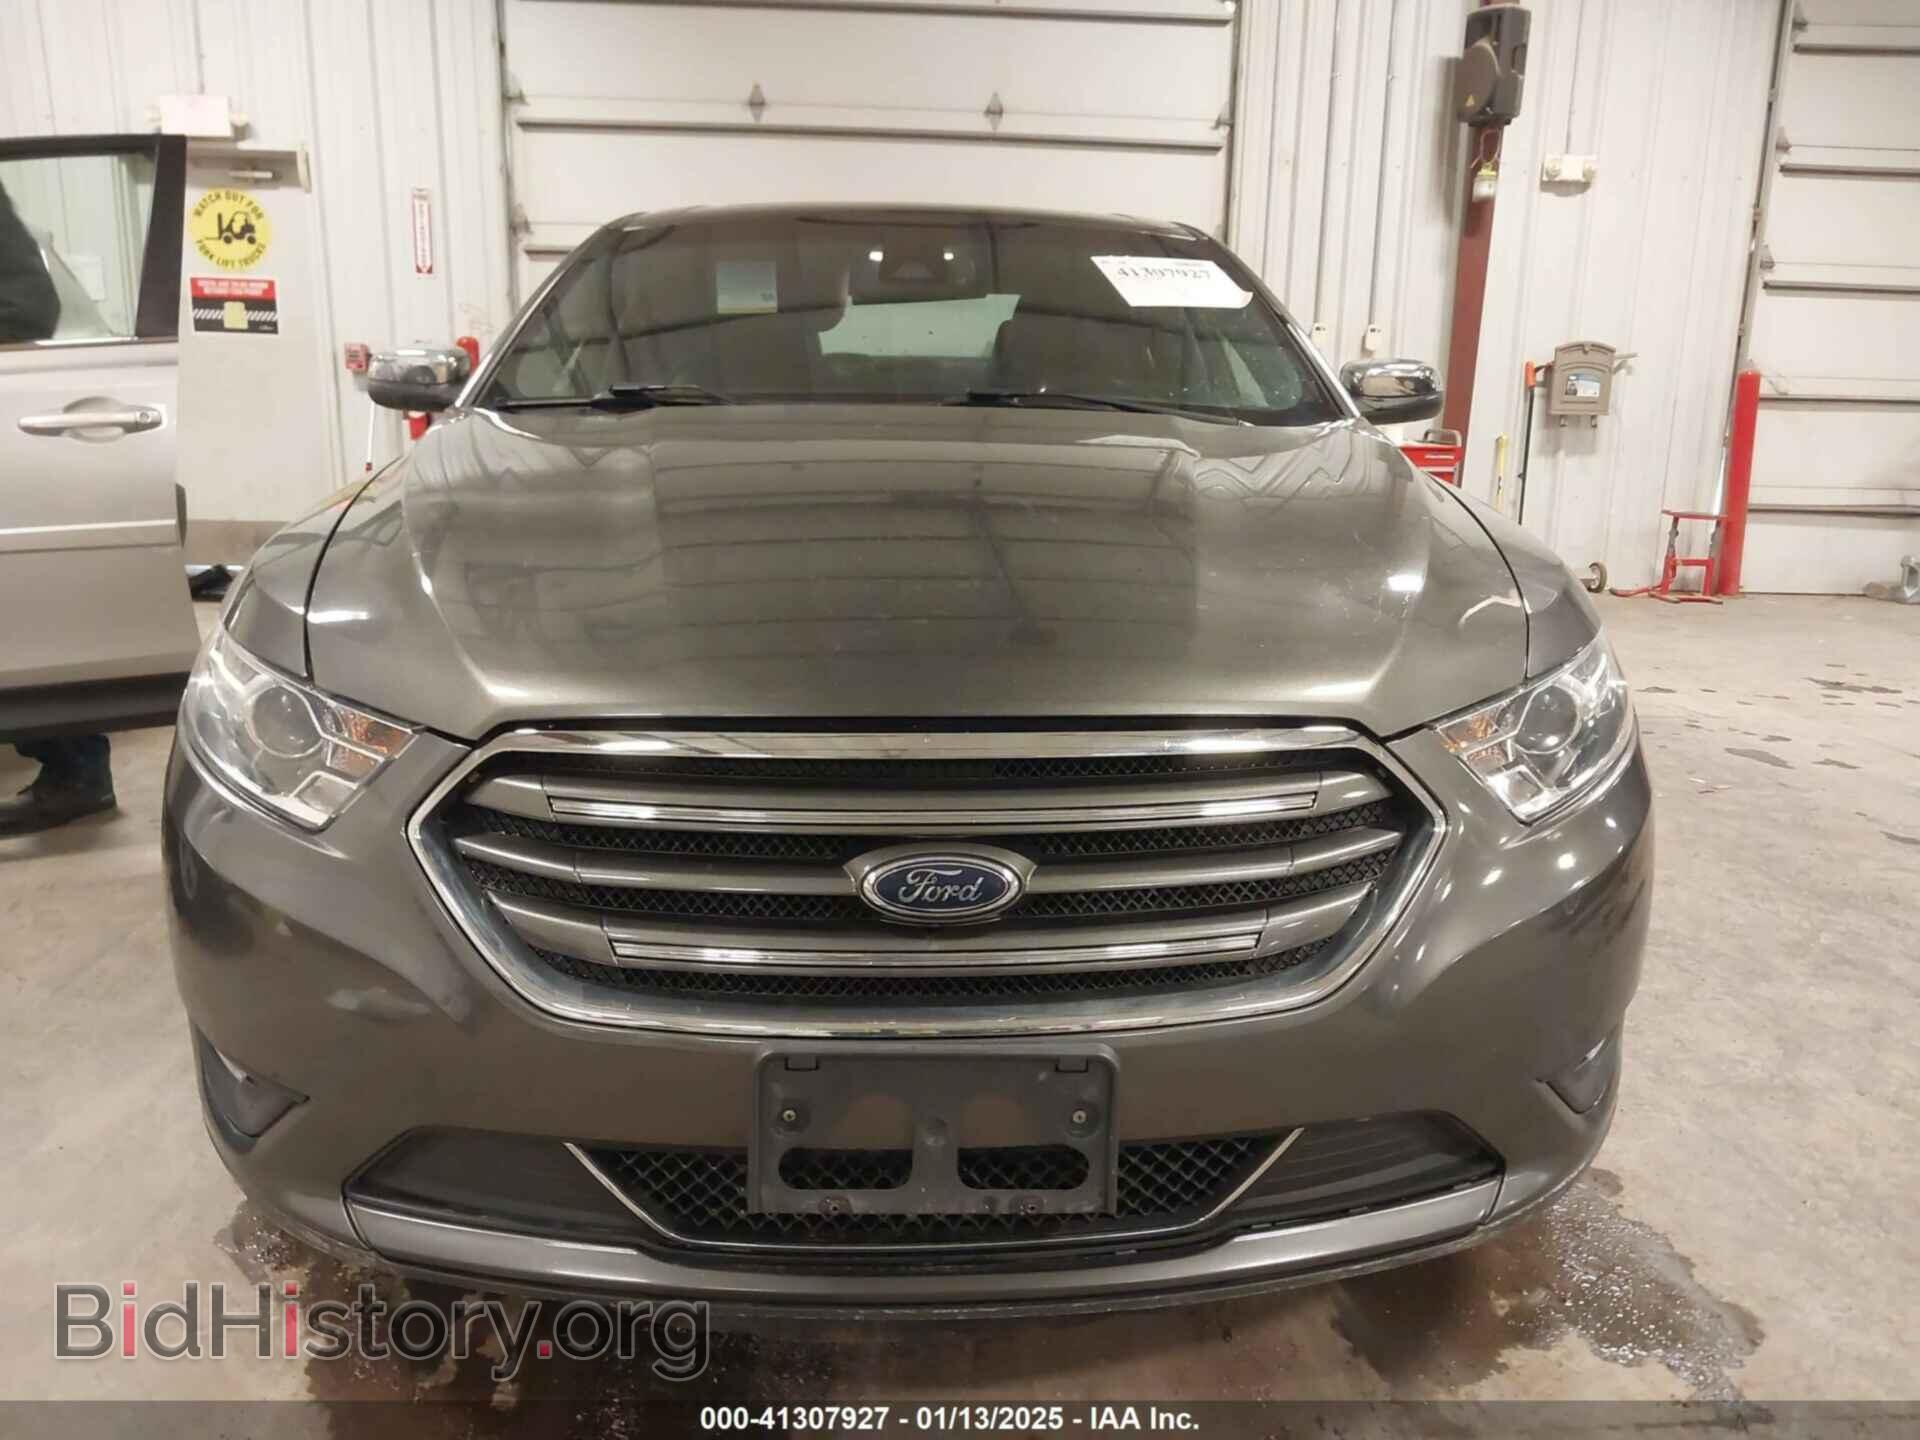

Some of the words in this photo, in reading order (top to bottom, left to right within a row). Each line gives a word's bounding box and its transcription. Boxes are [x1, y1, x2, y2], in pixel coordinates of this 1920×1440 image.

[193, 192, 221, 217] WATCH
[224, 191, 245, 204] OUT
[247, 200, 264, 220] FOR
[898, 868, 984, 903] Ford
